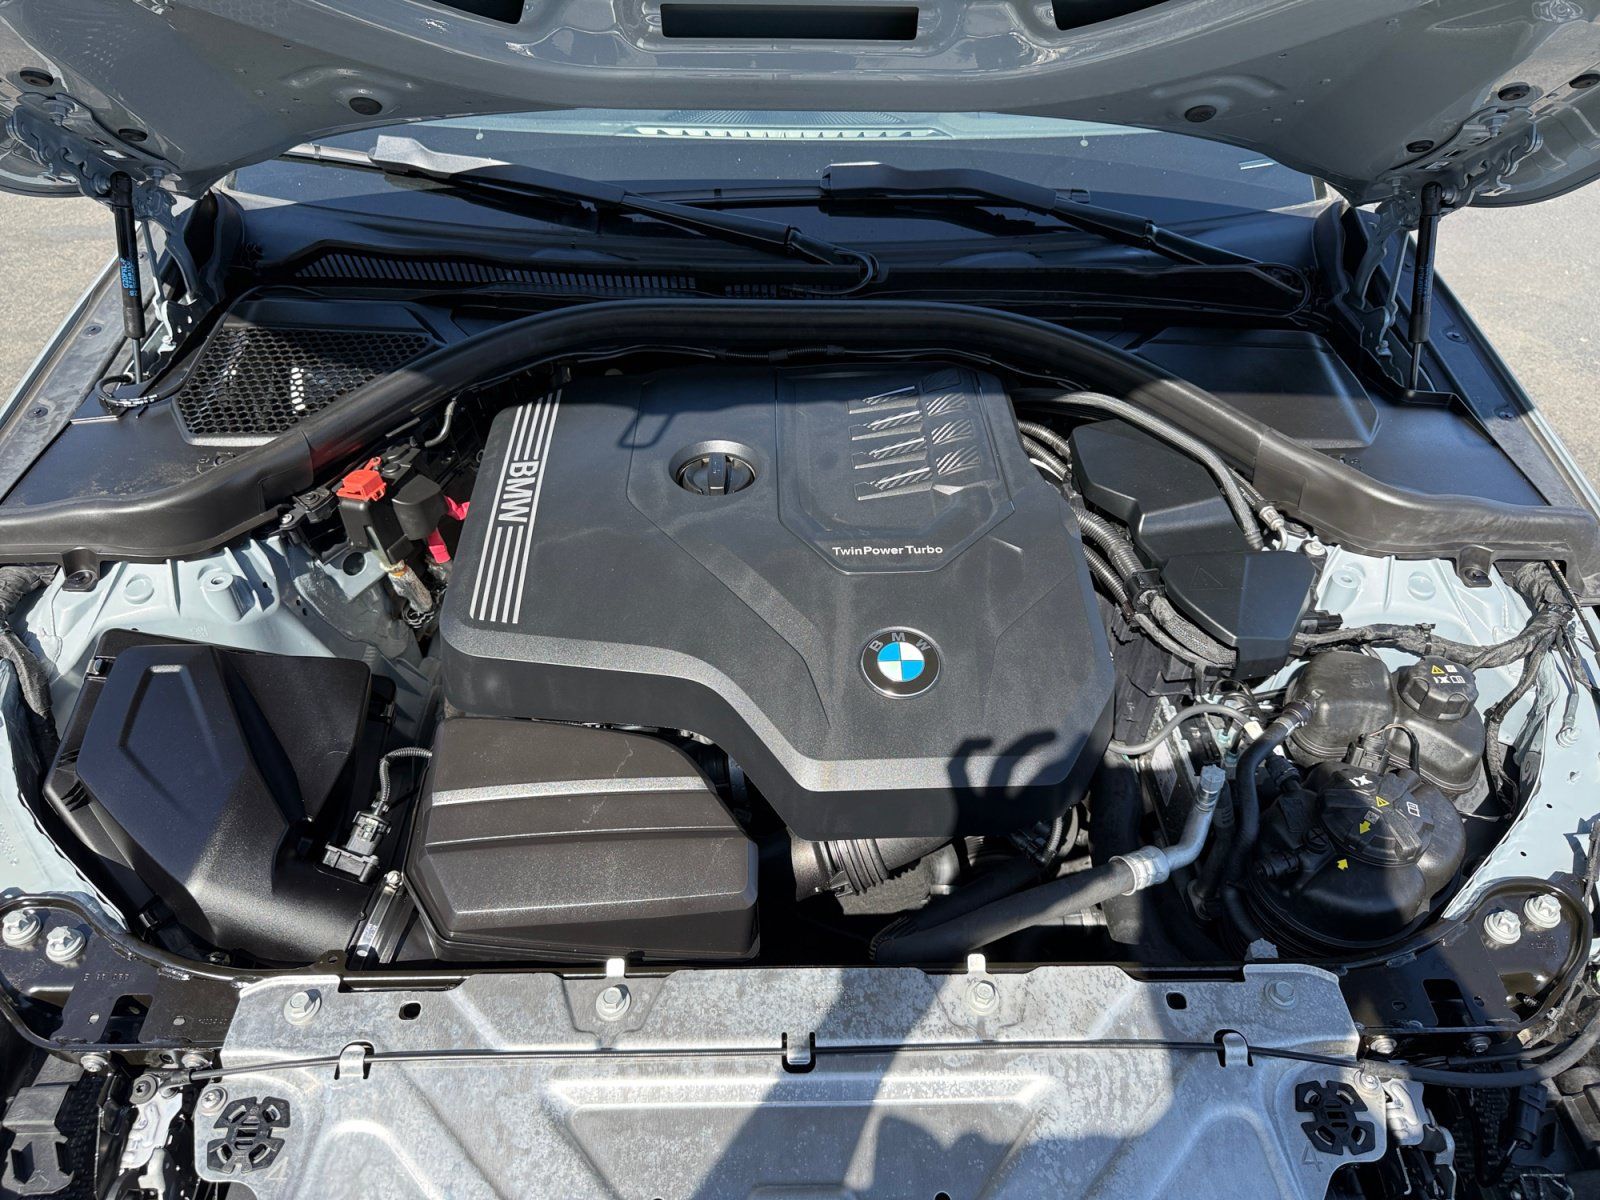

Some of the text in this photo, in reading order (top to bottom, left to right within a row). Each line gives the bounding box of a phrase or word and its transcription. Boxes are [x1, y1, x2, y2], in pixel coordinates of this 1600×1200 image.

[498, 460, 540, 523] BMW
[832, 545, 943, 555] TwinPower Turbo
[869, 632, 931, 653] BMW
